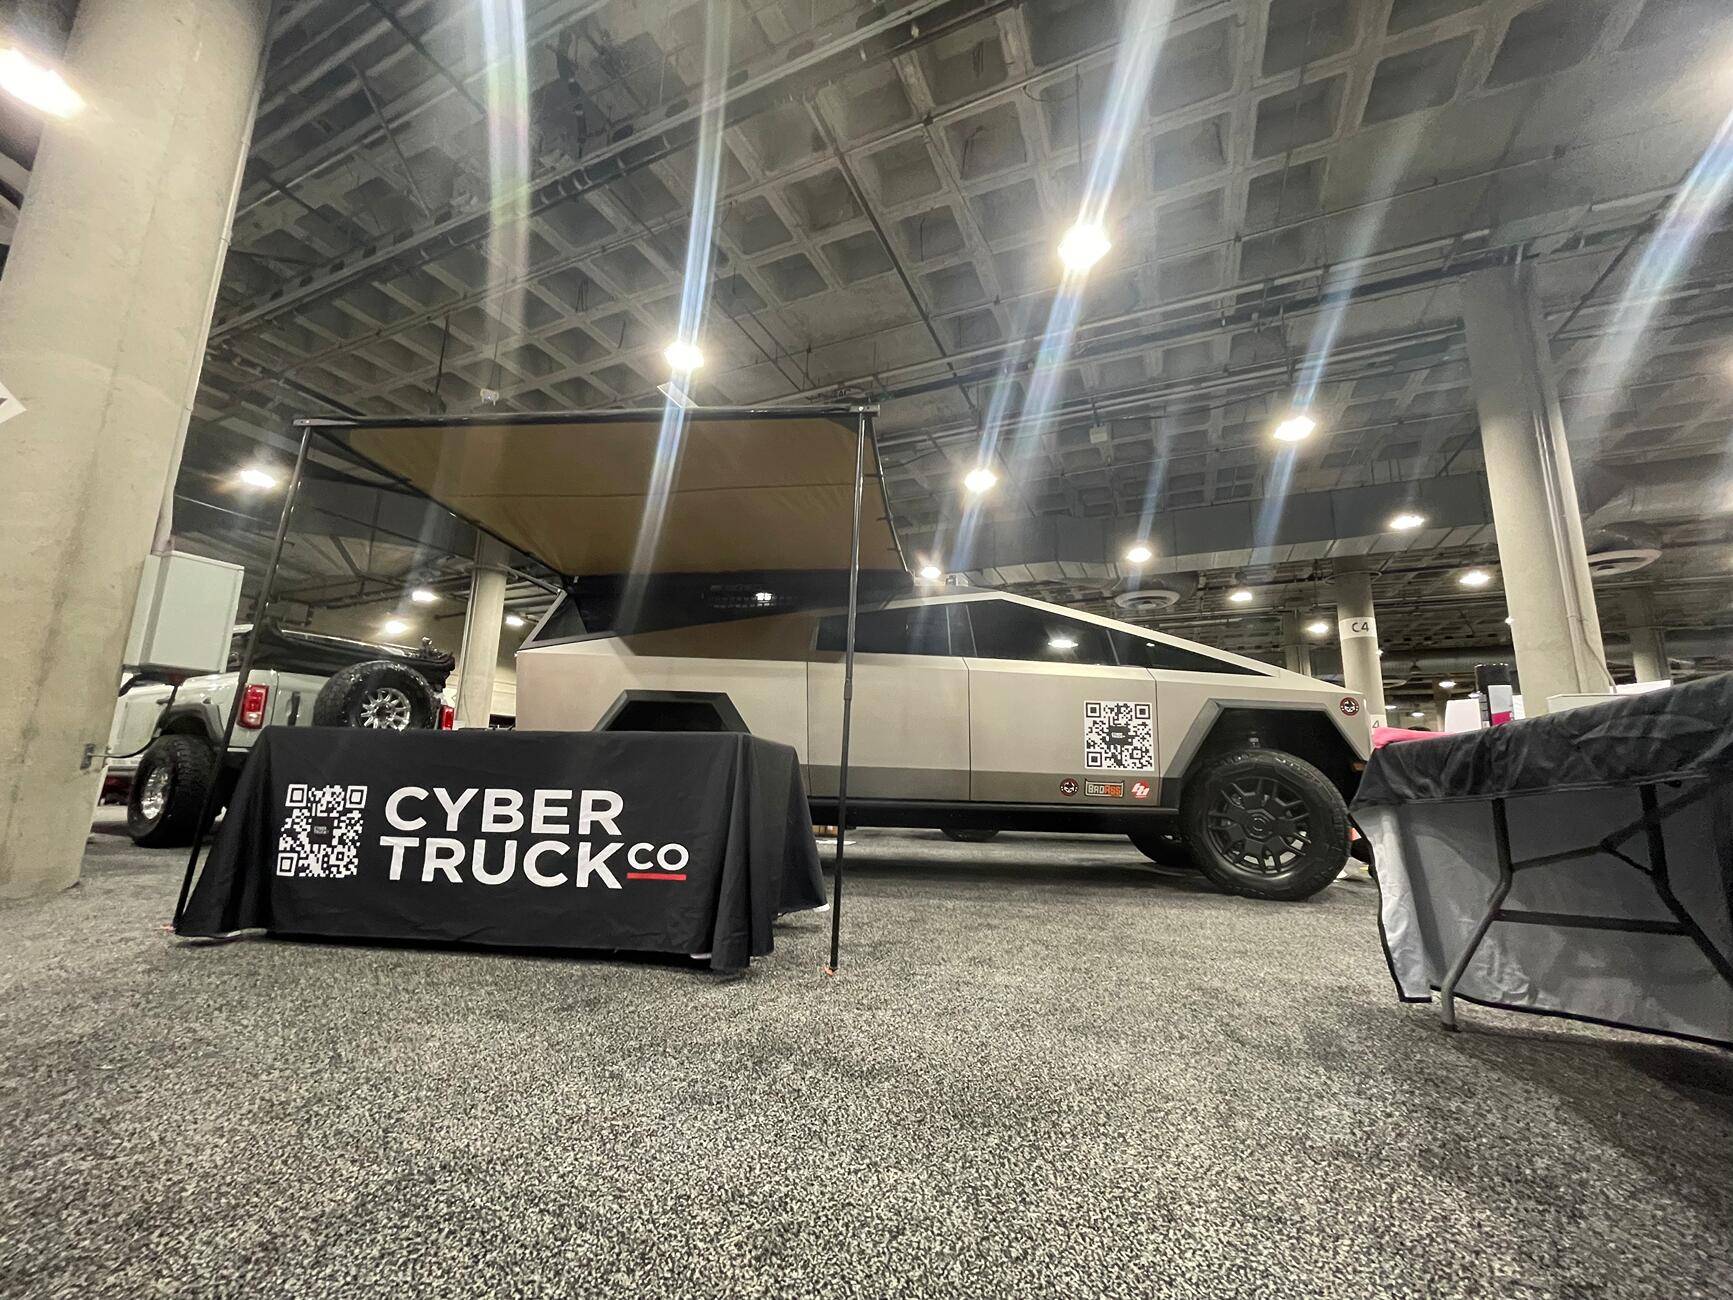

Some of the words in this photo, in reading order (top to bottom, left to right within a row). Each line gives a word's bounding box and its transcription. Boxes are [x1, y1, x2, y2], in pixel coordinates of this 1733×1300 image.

[1351, 621, 1370, 633] C4
[385, 786, 624, 836] CYBER
[379, 835, 625, 890] TRUCK
